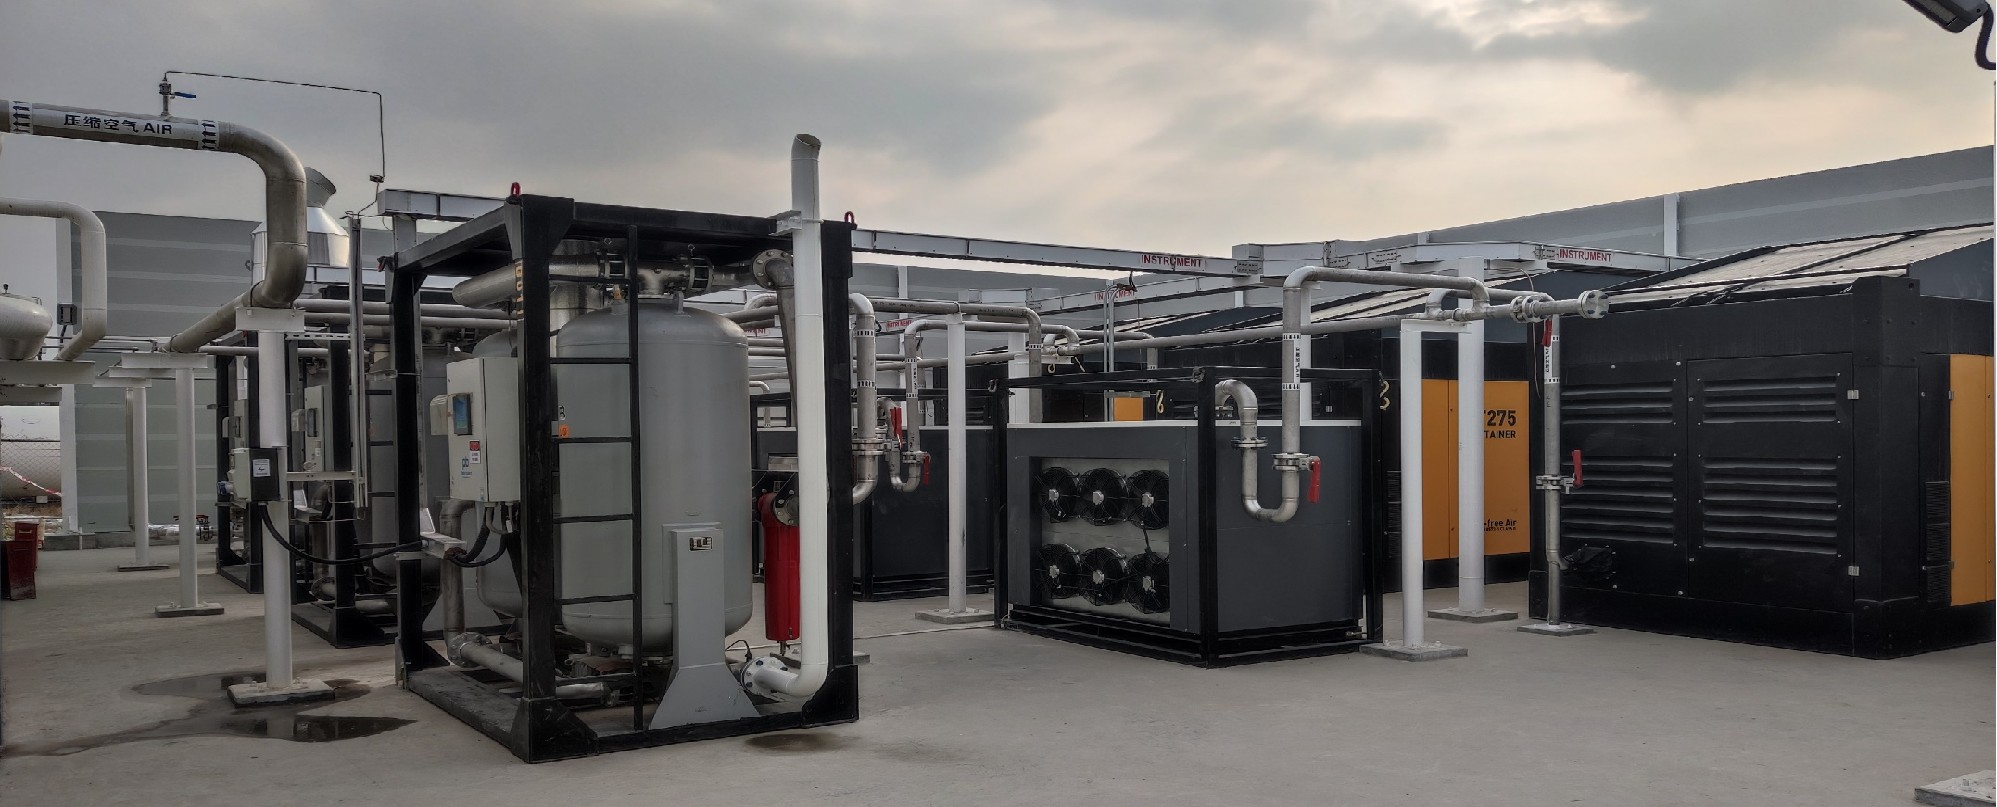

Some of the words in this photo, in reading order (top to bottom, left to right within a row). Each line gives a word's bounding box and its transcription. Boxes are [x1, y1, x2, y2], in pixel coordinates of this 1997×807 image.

[64, 114, 139, 133] 压缩空气
[143, 122, 172, 134] AIR
[1141, 254, 1202, 267] INSTRUMENT
[1560, 249, 1611, 262] INSTRUMENT
[1483, 409, 1517, 427] 275
[1505, 518, 1517, 527] Air
